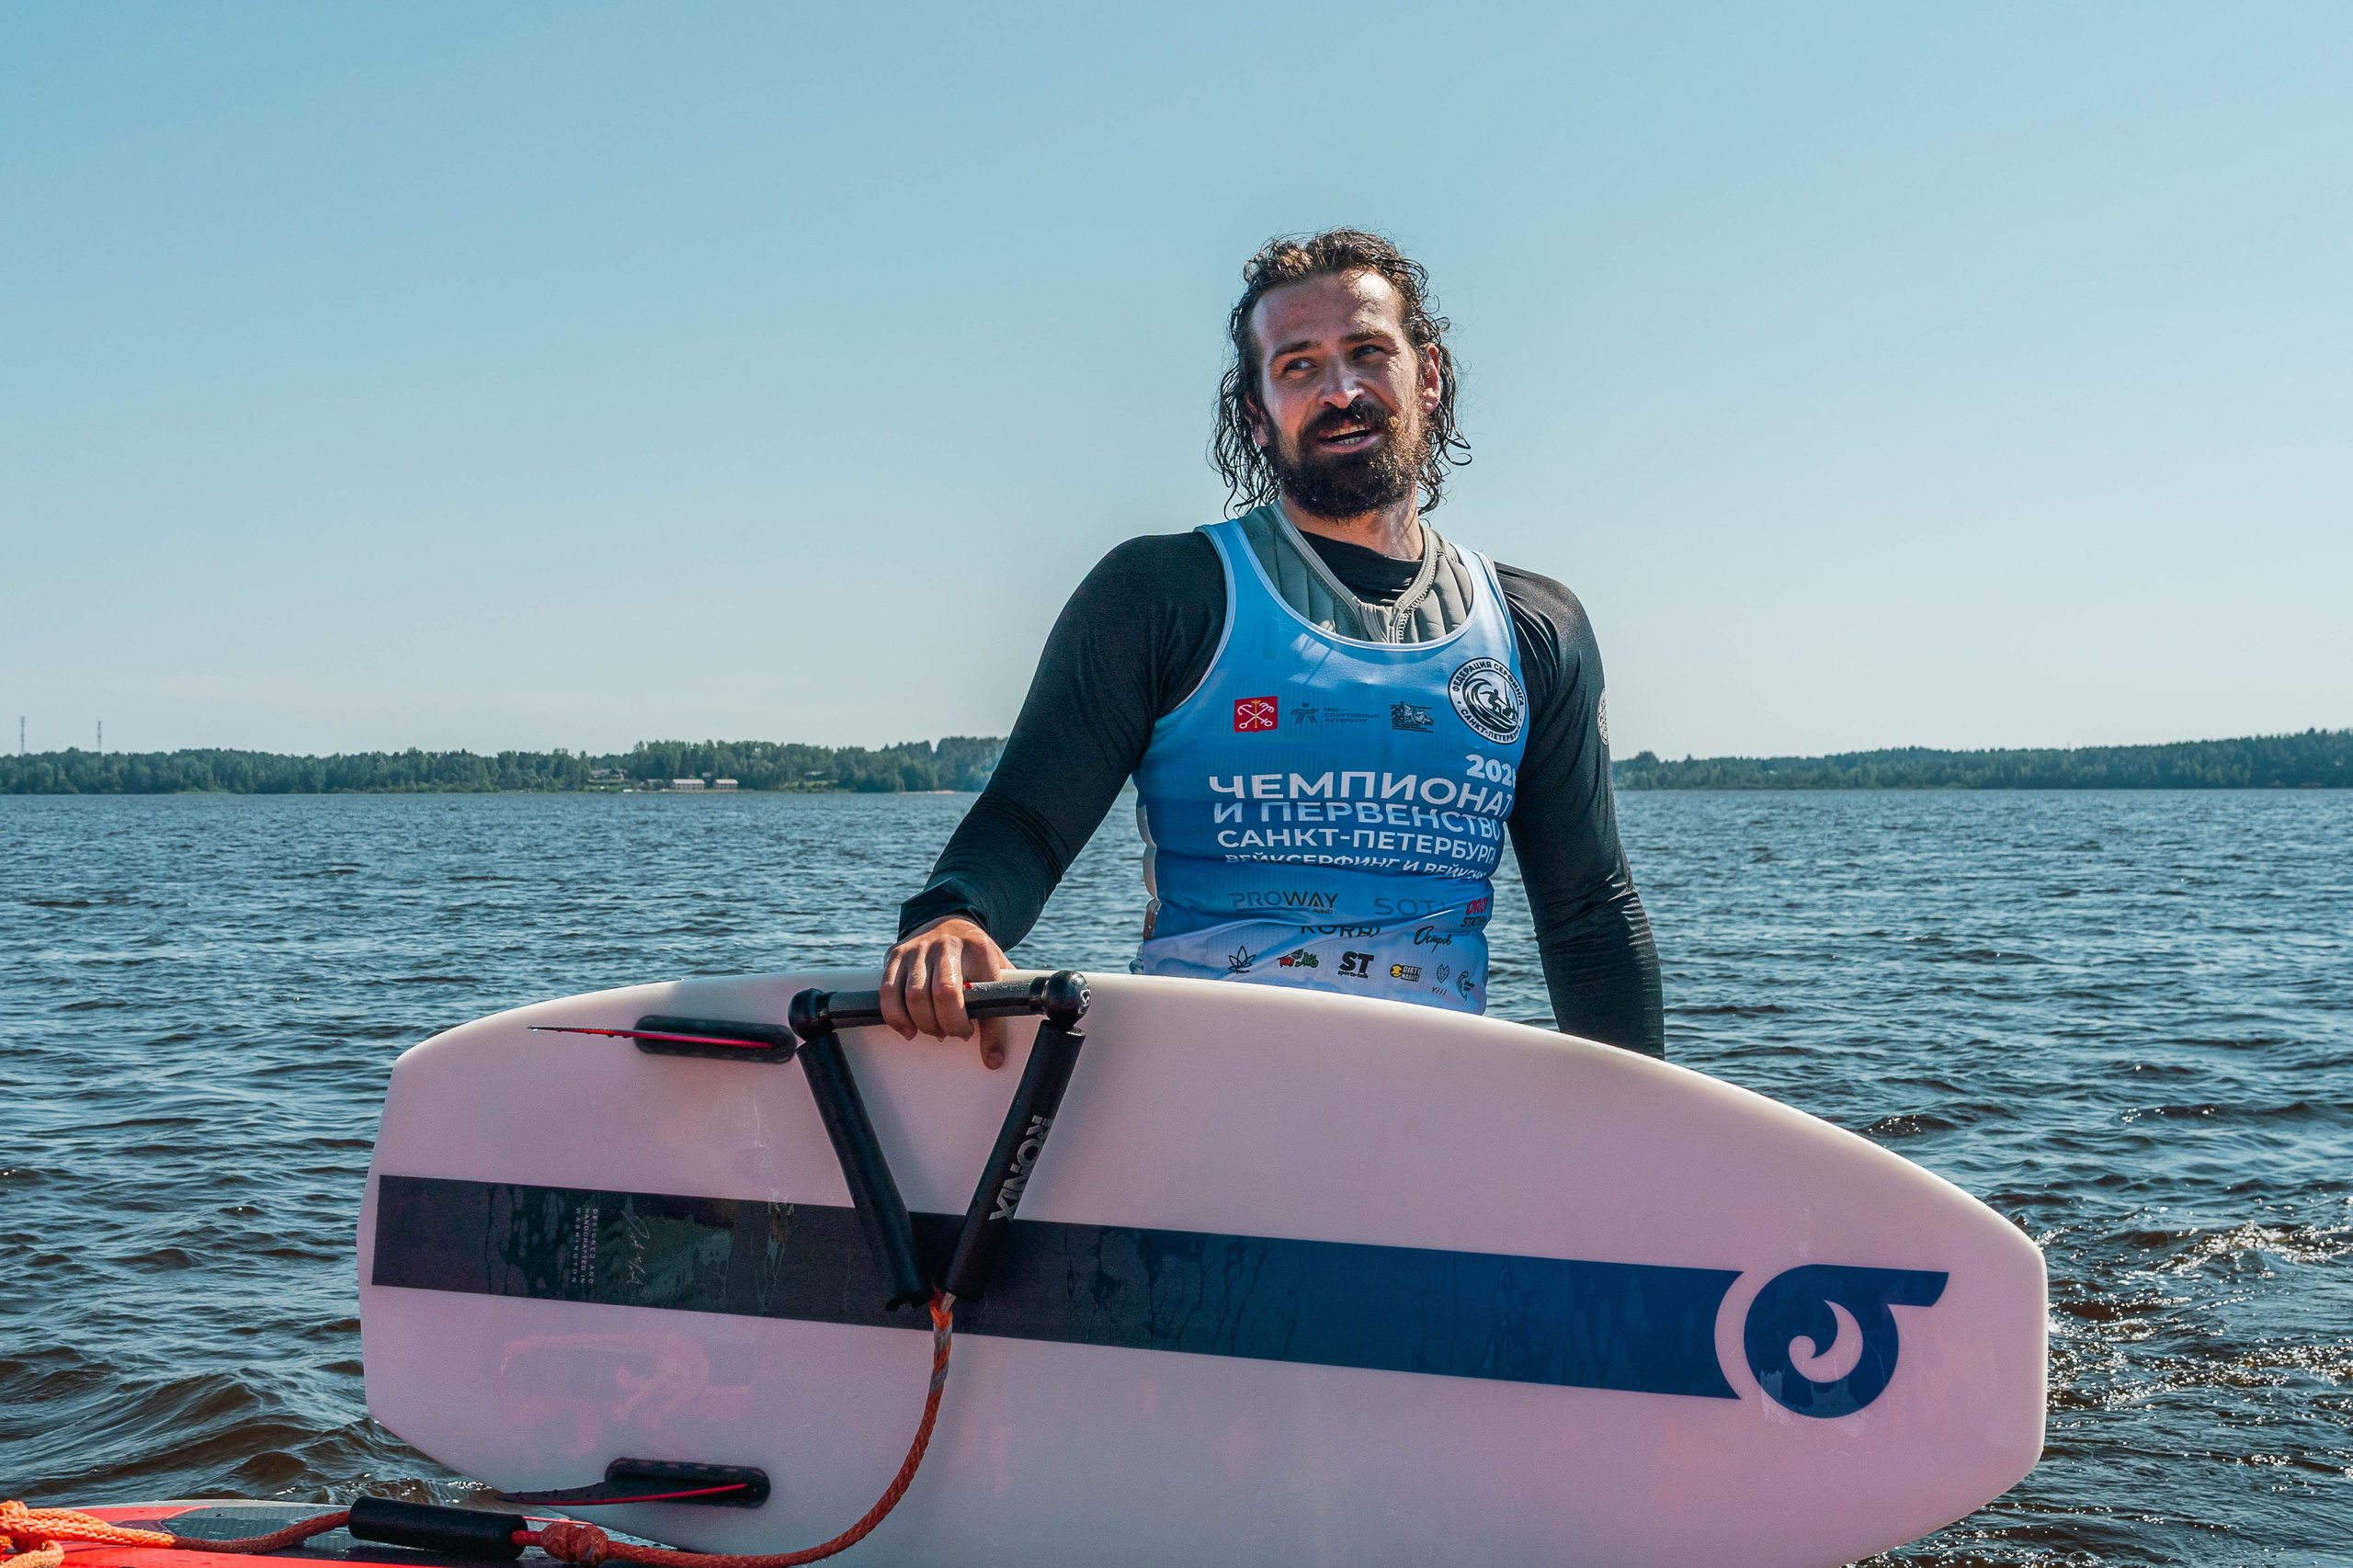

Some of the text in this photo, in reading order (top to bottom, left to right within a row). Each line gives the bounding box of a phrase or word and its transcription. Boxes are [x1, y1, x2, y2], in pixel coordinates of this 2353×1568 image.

[1452, 661, 1524, 707] ФЕДЕРАЦИЯ СЕРФИНГА
[1214, 801, 1501, 841] И ПЕРВЕНСТВО
[1403, 860, 1419, 871] И
[1227, 891, 1339, 908] PROWAY
[1414, 926, 1452, 953] Остров
[1339, 950, 1374, 973] ST
[1401, 972, 1419, 982] HABITS
[1403, 965, 1422, 974] DIRTY
[988, 1114, 1055, 1221] RONIX
[572, 1207, 582, 1282] WASHINGTON
[580, 1208, 590, 1283] HANDCRAFTED IN
[590, 1209, 598, 1258] DESIGNED
